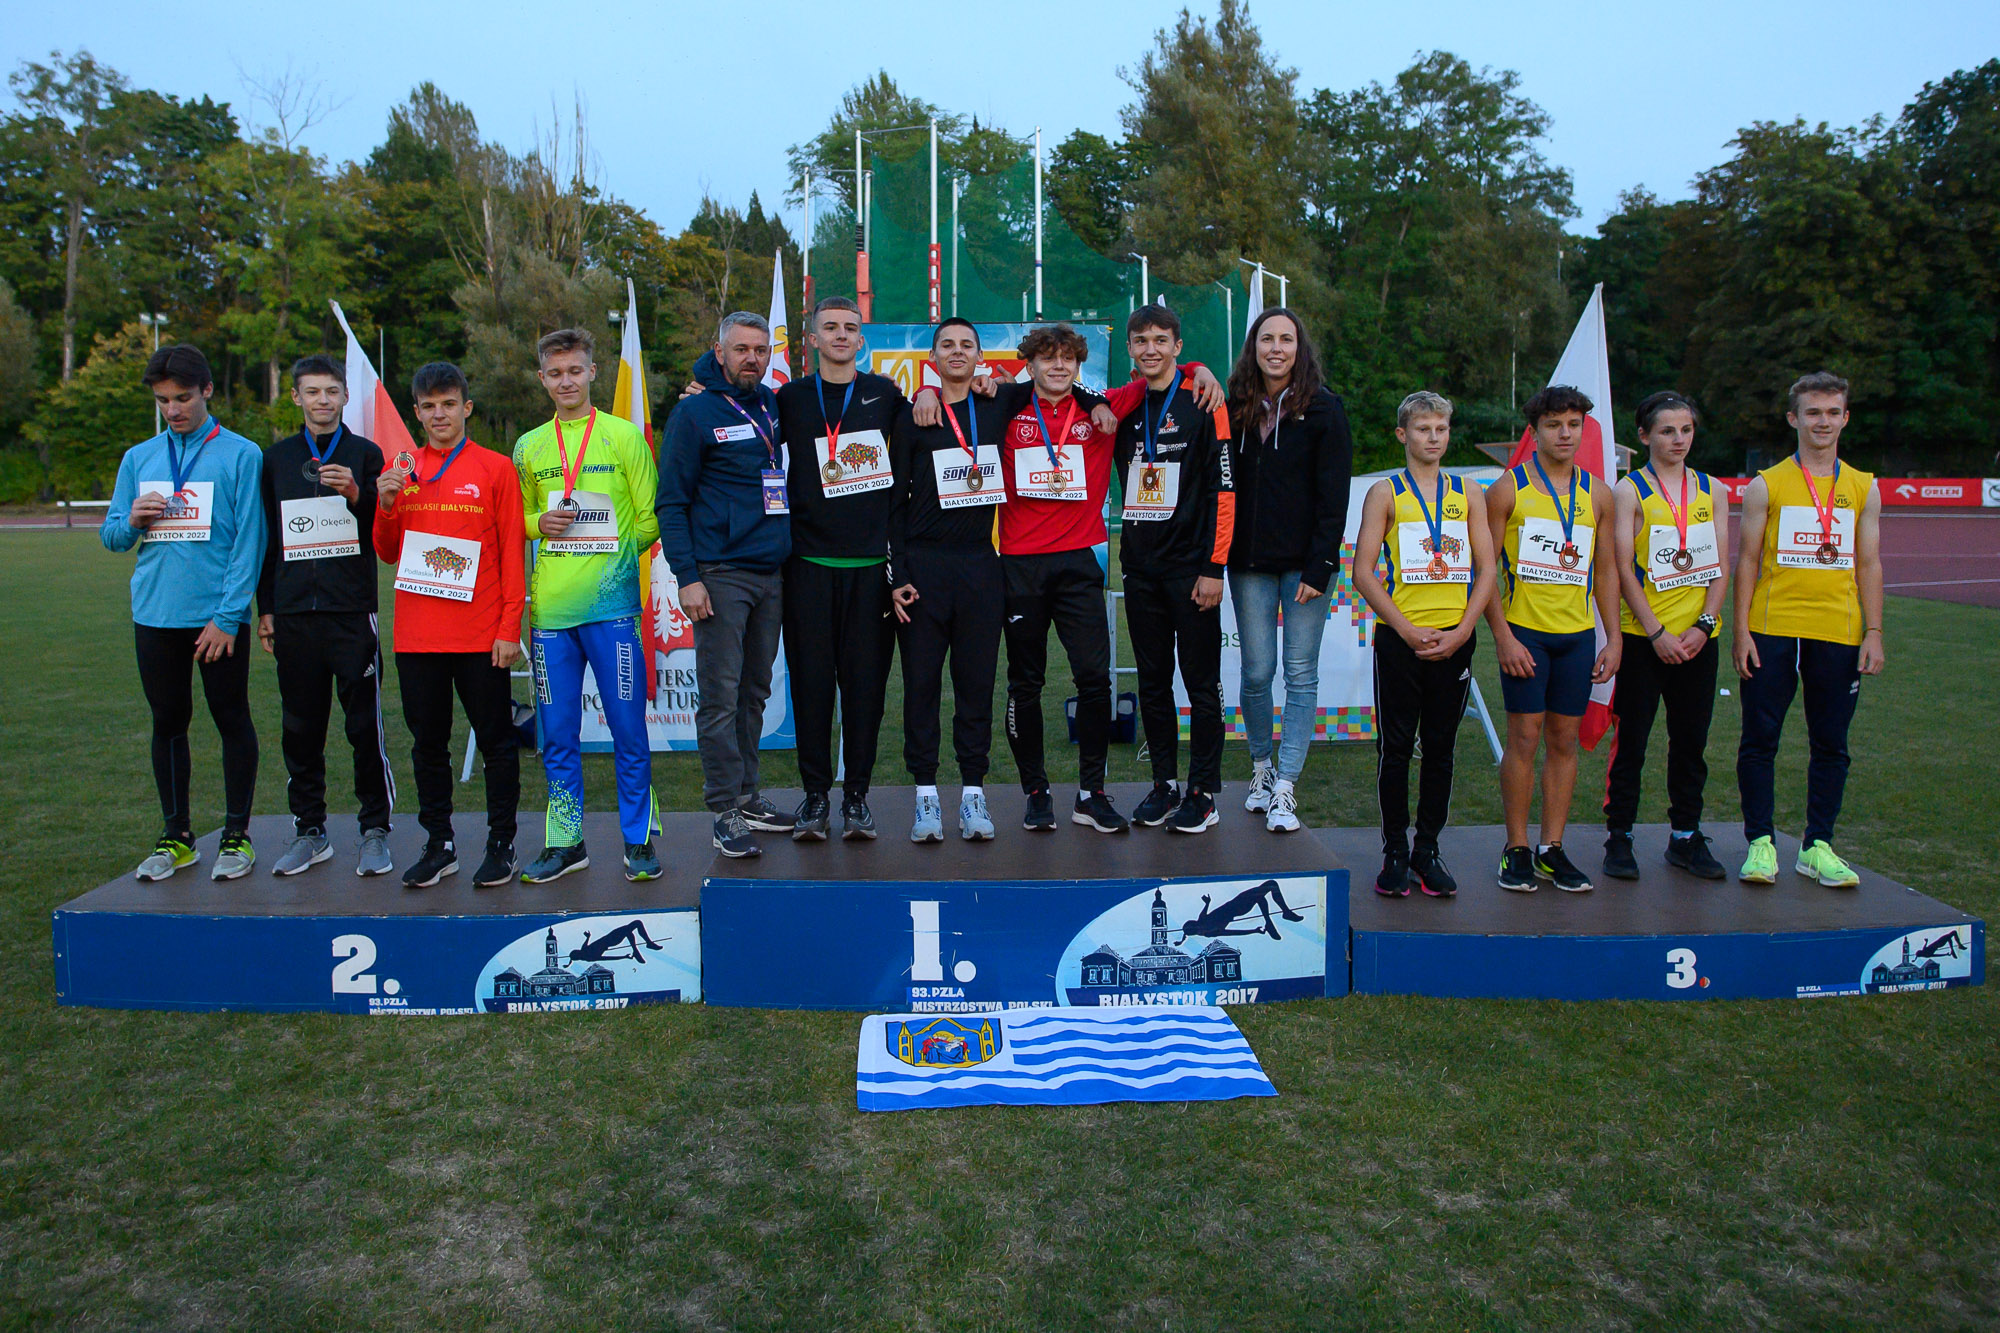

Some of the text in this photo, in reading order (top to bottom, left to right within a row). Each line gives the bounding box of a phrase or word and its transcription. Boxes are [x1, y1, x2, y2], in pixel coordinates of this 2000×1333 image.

[828, 482, 870, 495] BIAŁYSTOK
[871, 478, 890, 488] 2022
[1923, 488, 1960, 496] ORLEN
[944, 495, 1003, 507] BIAŁYSTOK 2022
[1834, 497, 1848, 505] VIS
[405, 504, 439, 513] PODLASIE
[441, 503, 484, 514] BIAŁYSTOK
[1125, 511, 1157, 519] BIAŁYSTOK
[320, 518, 351, 528] Okęcie
[186, 531, 207, 539] 2022
[1529, 534, 1547, 543] 4F
[288, 545, 356, 559] BIAŁYSTOK 2022
[404, 567, 434, 578] Podlaskie
[1451, 573, 1467, 581] 2022
[1521, 566, 1563, 579] BIAŁYSTOK
[1564, 574, 1583, 583] 2022
[1659, 574, 1698, 590] BIAŁYSTOK
[1699, 570, 1717, 579] 2022
[399, 582, 446, 596] BIAŁYSTOK
[447, 590, 468, 599] 2022
[618, 642, 633, 700] SONAROL
[910, 900, 976, 982] 1.
[332, 934, 400, 995] 2.
[1878, 980, 1948, 993] BIAŁYSTOK 2017
[1099, 987, 1259, 1007] BIAŁYSTOK 2017
[507, 997, 629, 1014] BIAŁYSTOK 2017
[912, 1001, 1004, 1013] MISTRZOSTWA
